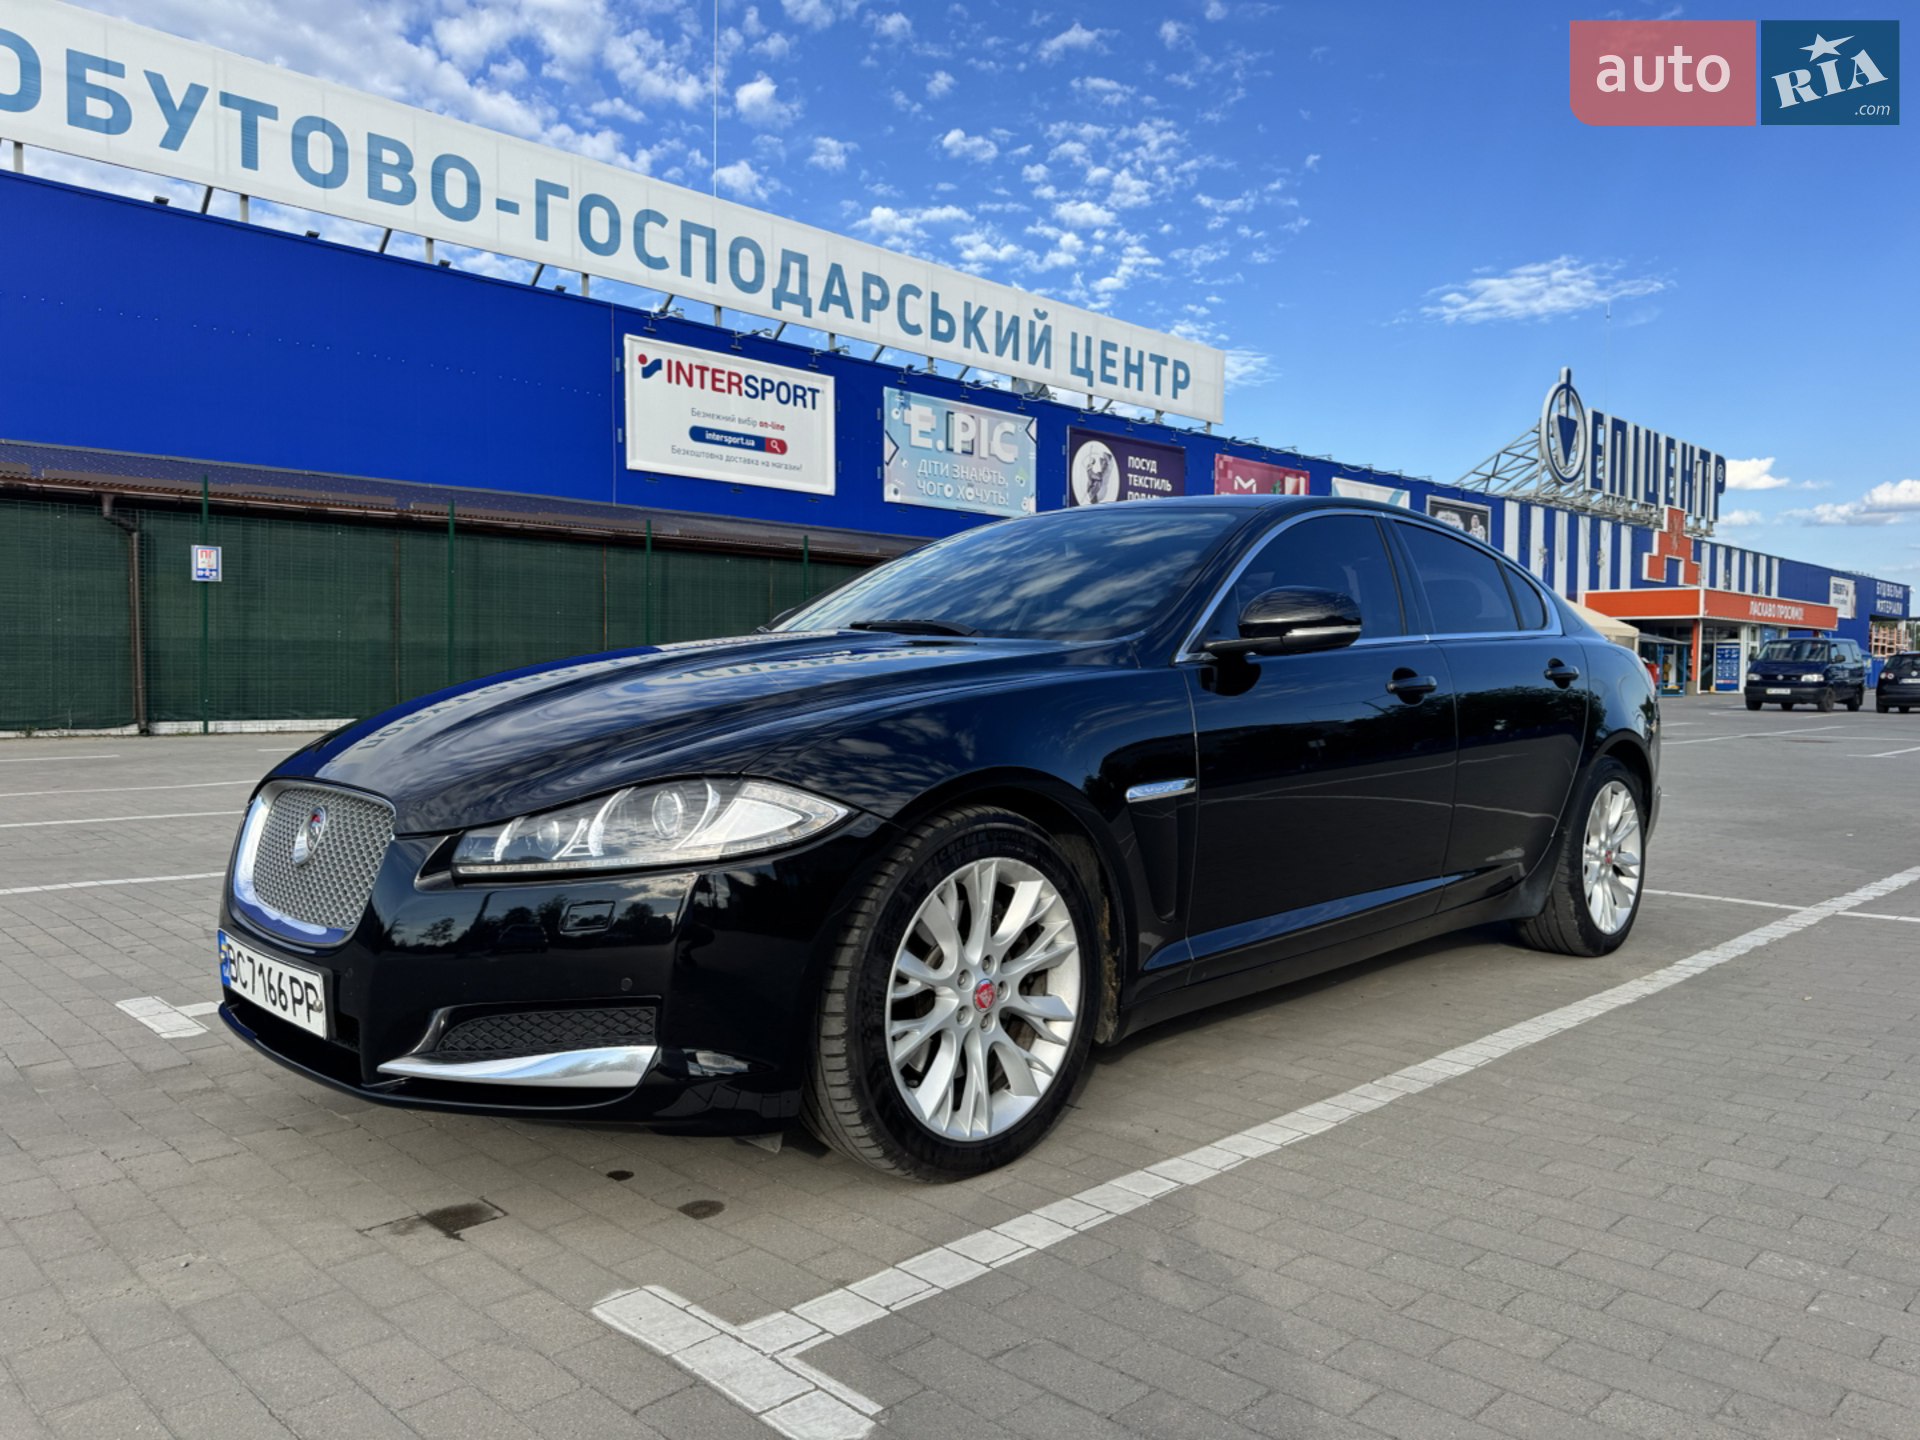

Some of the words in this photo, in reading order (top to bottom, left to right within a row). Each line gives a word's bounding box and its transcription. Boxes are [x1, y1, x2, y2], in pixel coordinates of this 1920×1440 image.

[1070, 331, 1191, 400] ЦЕНТР
[666, 358, 821, 411] INTERSPORT
[737, 416, 758, 428] вибір
[705, 430, 756, 447] intersport.ua
[917, 458, 949, 478] ДІТИ
[1127, 455, 1158, 475] ПОСУД
[1127, 473, 1173, 492] ТЕКСТИЛЬ
